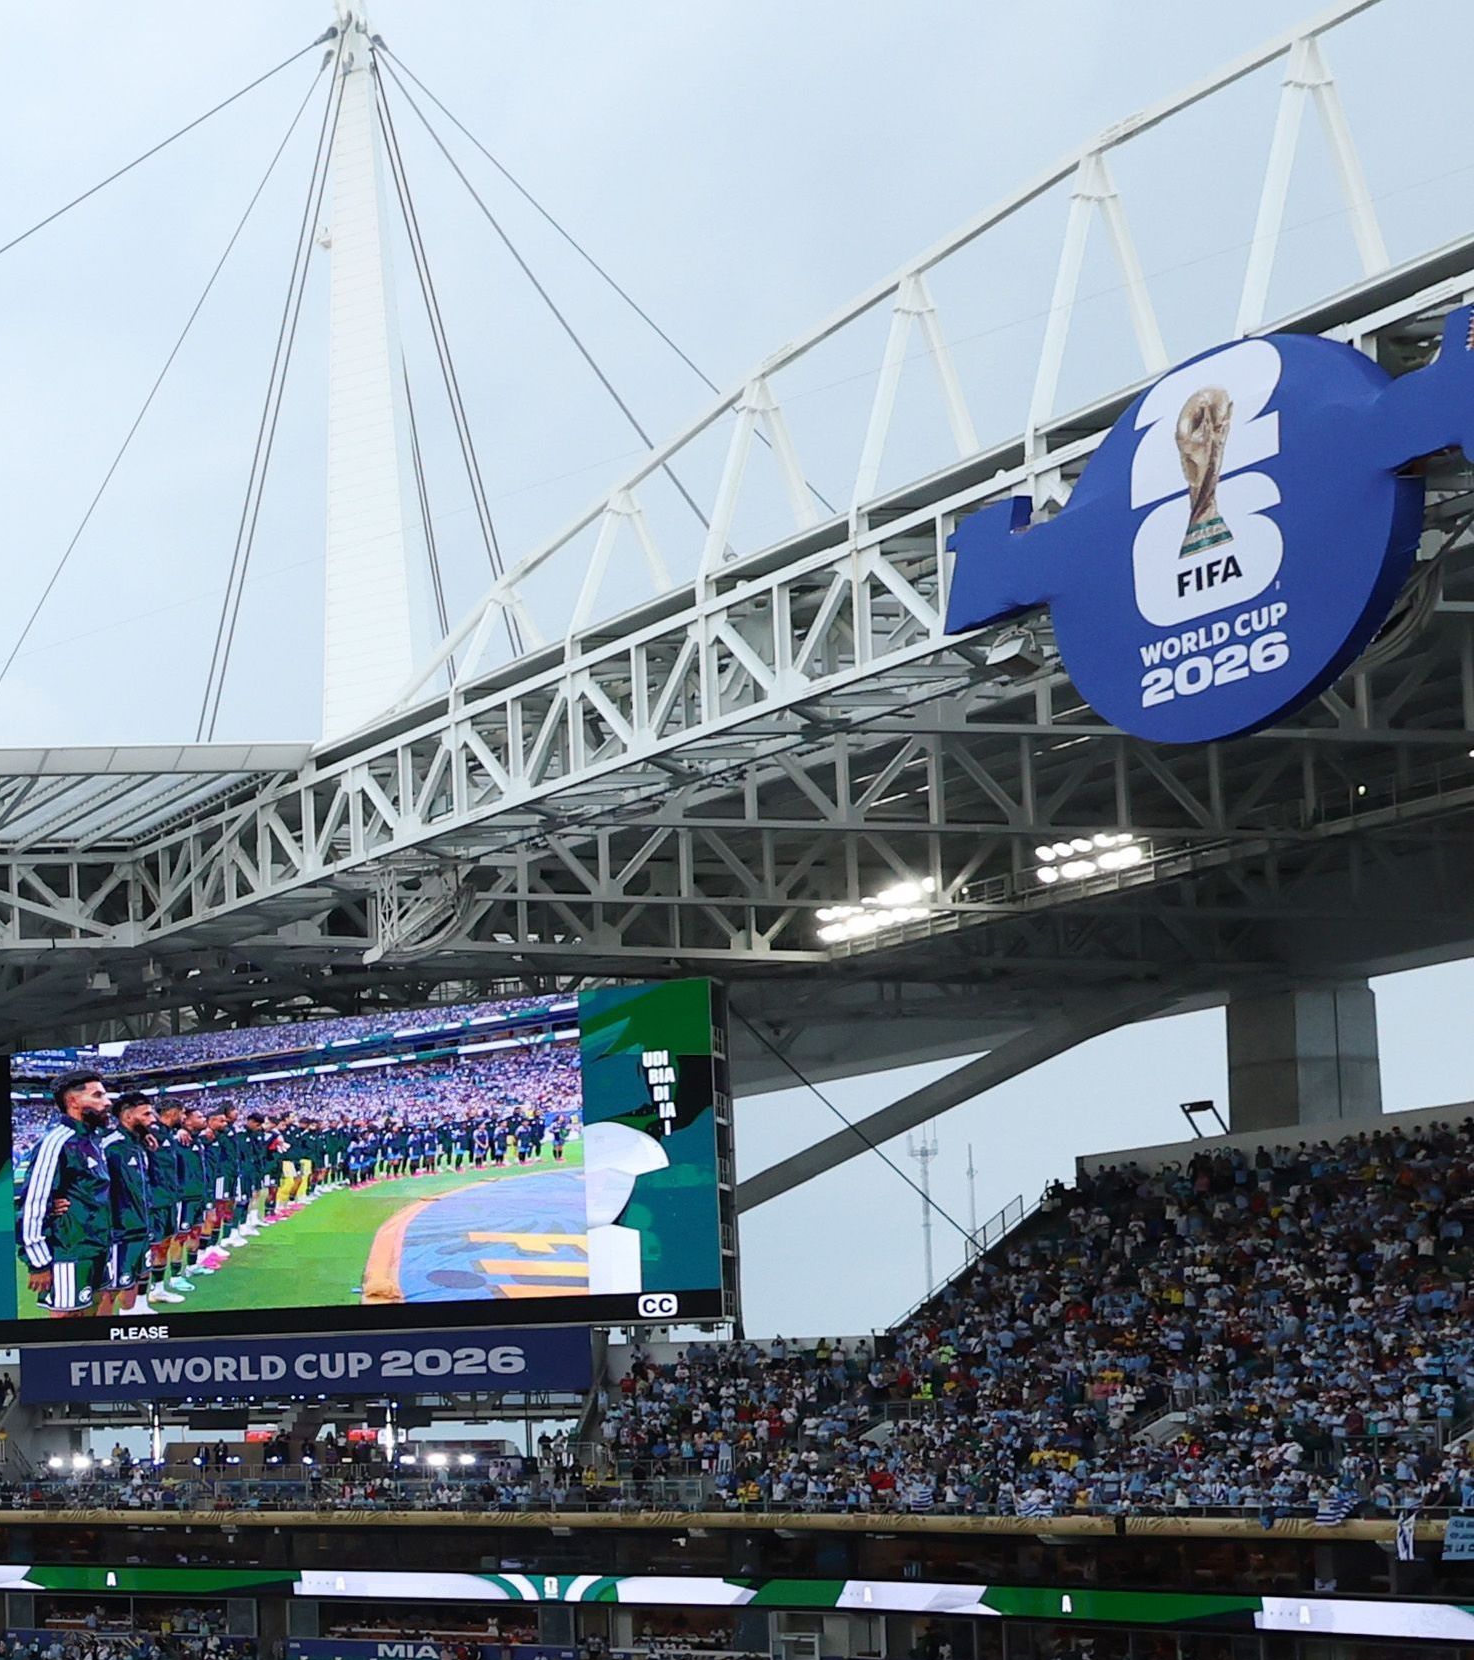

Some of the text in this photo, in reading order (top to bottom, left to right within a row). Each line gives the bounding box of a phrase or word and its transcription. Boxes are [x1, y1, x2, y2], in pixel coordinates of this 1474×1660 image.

[1177, 554, 1243, 599] FIFA
[1139, 601, 1288, 668] WORLD CUP
[1141, 631, 1290, 709] 2026
[642, 1050, 670, 1068] UDI
[648, 1067, 675, 1084] BIA
[653, 1084, 672, 1101] DI
[658, 1101, 675, 1118] IA
[643, 1295, 674, 1315] CC
[110, 1325, 169, 1341] PLEASE
[69, 1346, 527, 1387] FIFA WORLD CUP 2026
[377, 1643, 440, 1660] MIA
